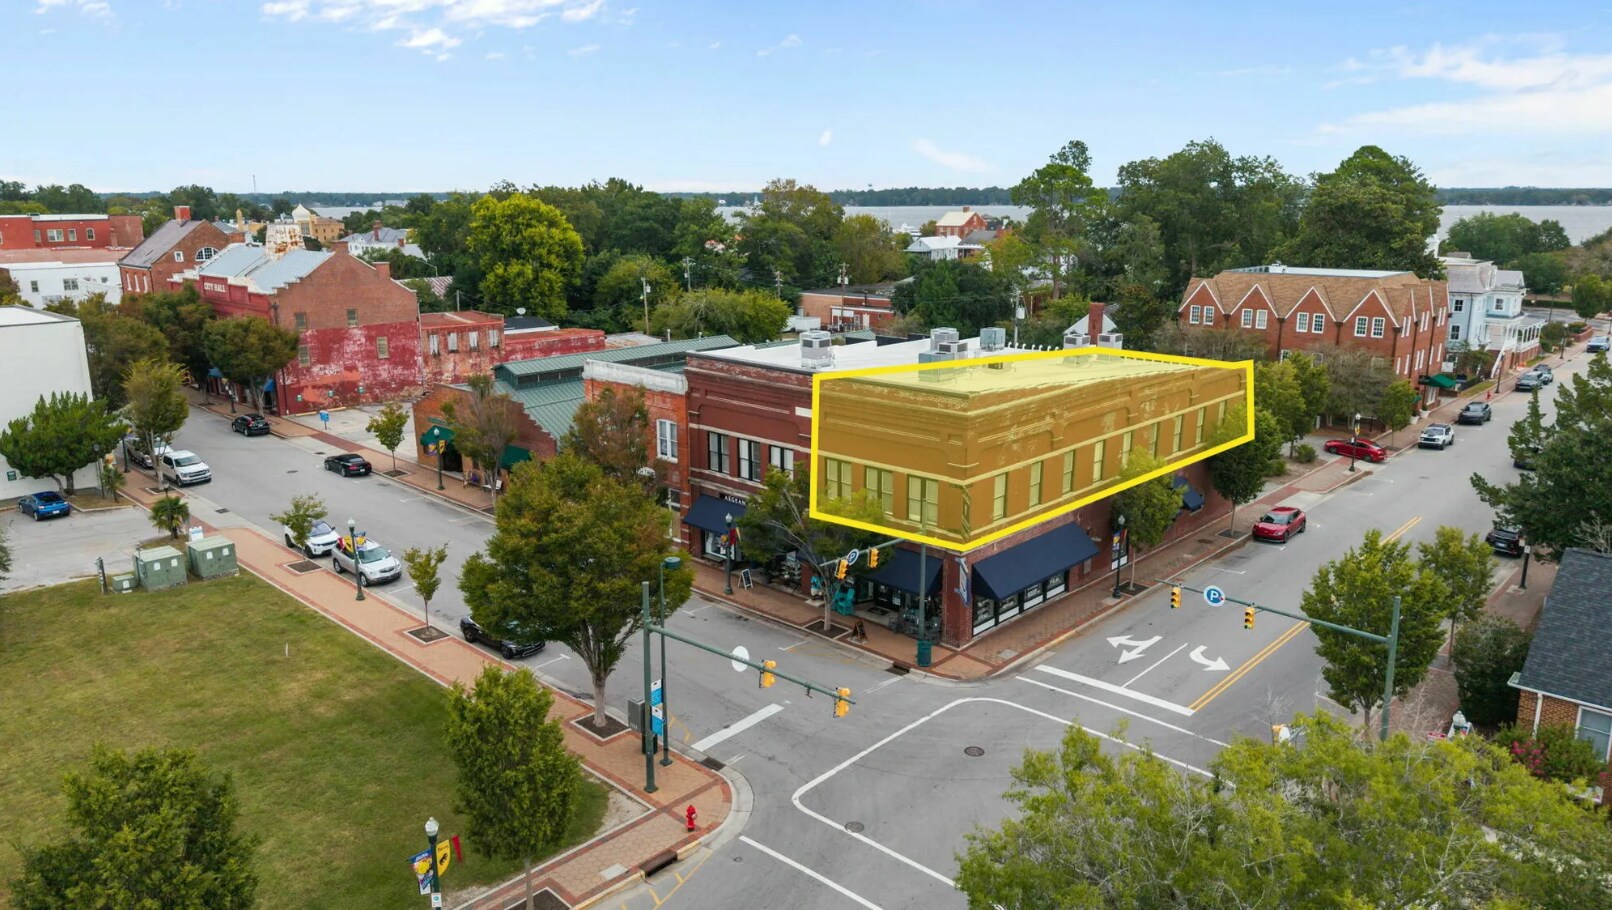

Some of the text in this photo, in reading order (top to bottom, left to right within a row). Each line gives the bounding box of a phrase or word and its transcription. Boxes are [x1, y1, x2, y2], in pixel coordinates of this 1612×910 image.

[203, 281, 227, 293] CITY HALL
[724, 495, 746, 506] AEGEAN
[1210, 590, 1219, 601] P
